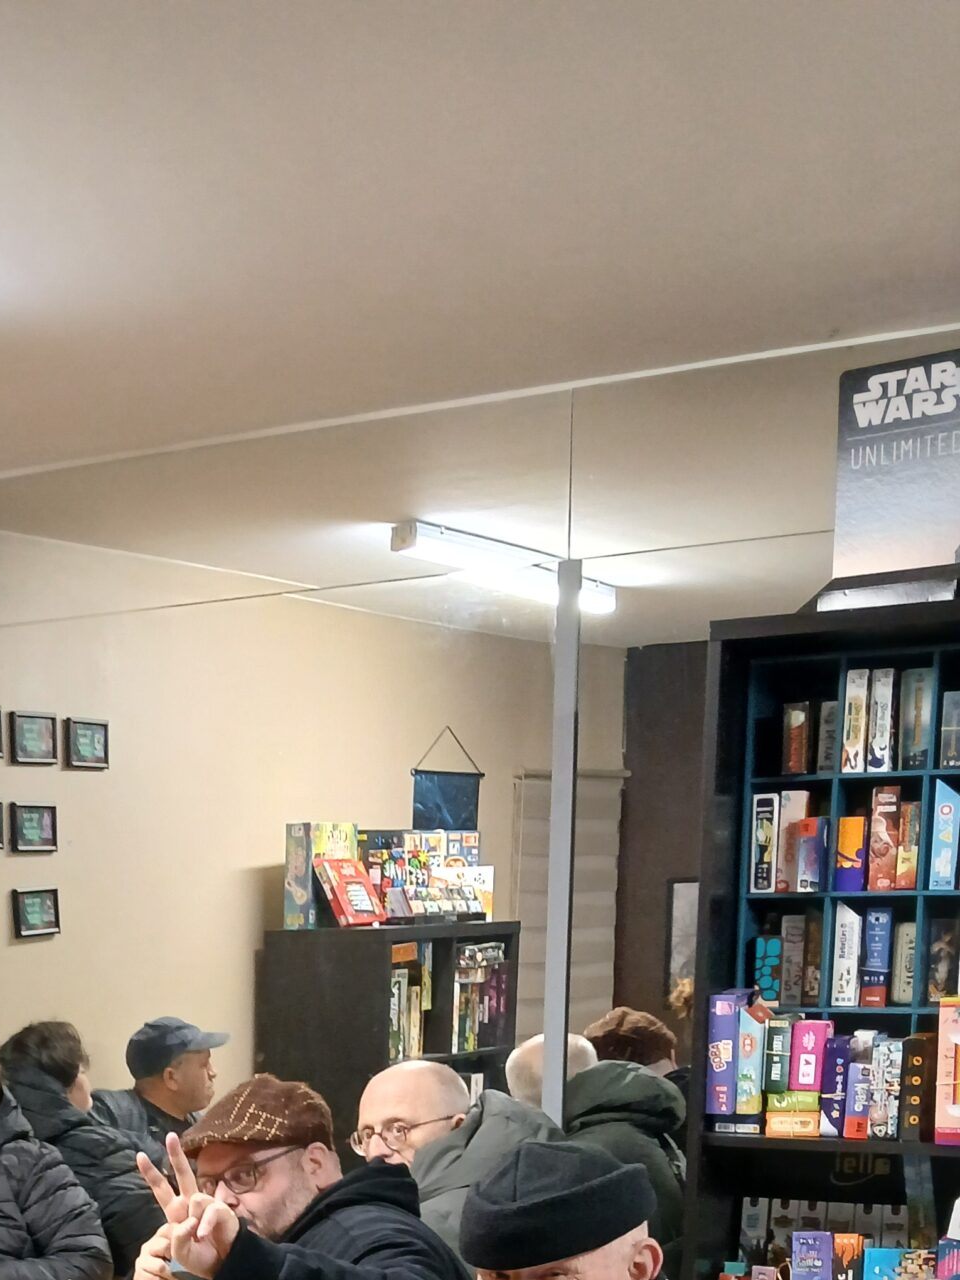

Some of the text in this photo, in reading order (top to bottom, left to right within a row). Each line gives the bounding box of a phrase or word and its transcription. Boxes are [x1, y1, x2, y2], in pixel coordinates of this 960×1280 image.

[853, 361, 960, 404] STAR
[853, 386, 960, 428] WARS
[851, 431, 960, 470] UNLIMITED
